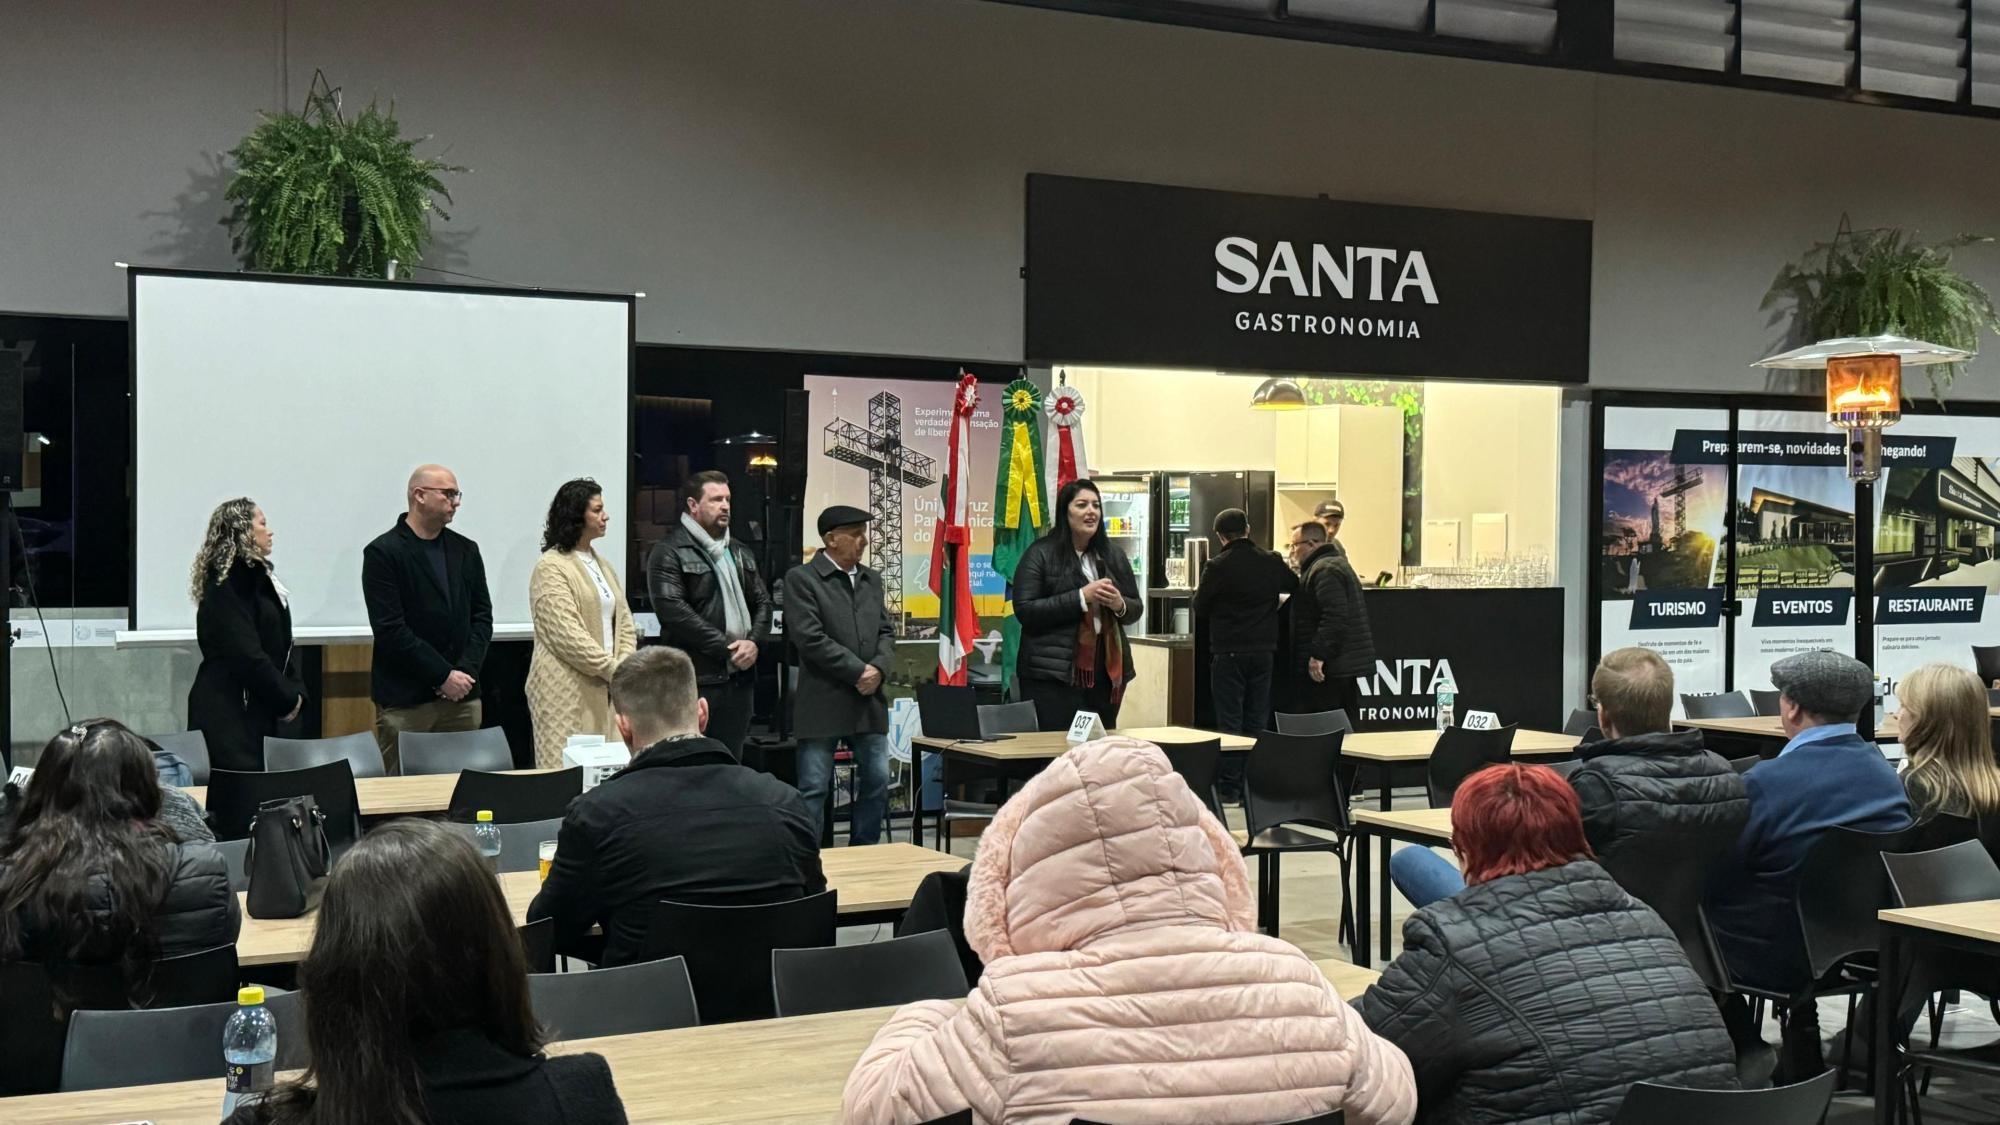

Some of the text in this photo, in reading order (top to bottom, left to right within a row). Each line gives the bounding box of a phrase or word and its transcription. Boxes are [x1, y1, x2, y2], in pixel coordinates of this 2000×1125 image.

[1214, 236, 1440, 305] SANTA
[1235, 311, 1421, 339] GASTRONOMIA
[915, 407, 953, 418] Experim
[914, 417, 999, 429] verdadei nsação
[914, 427, 950, 437] de liber
[1786, 441, 1841, 455] novidades
[1880, 444, 1927, 459] hegando!
[914, 495, 938, 512] Úni
[913, 529, 931, 542] do
[1648, 601, 1707, 617] TURISMO
[1772, 600, 1833, 615] EVENTOS
[1888, 598, 1974, 613] RESTAURANTE
[1356, 658, 1459, 696] NTA
[1359, 705, 1436, 721] TRONOMI
[1074, 714, 1092, 730] 037
[1466, 714, 1488, 729] 032
